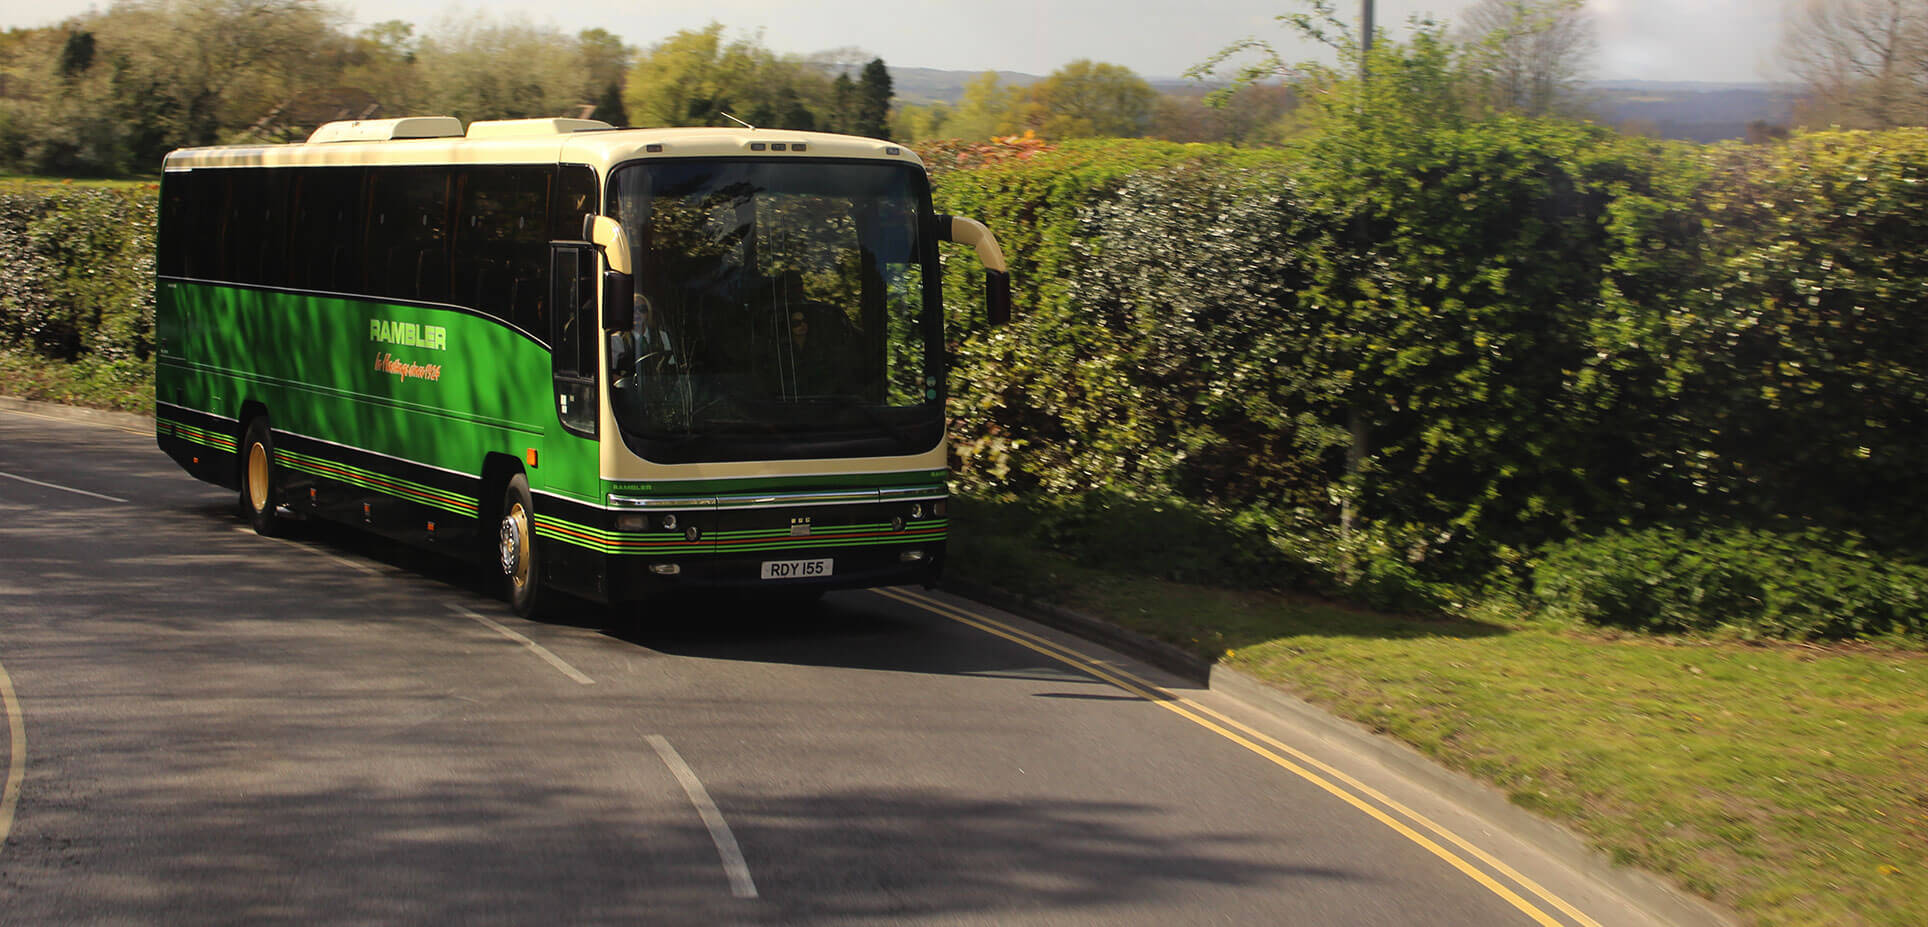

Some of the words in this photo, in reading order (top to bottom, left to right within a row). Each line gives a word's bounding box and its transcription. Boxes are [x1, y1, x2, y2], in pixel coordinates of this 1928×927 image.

[370, 319, 447, 351] RAMBLER
[770, 562, 799, 577] RDY
[802, 561, 824, 576] 155
